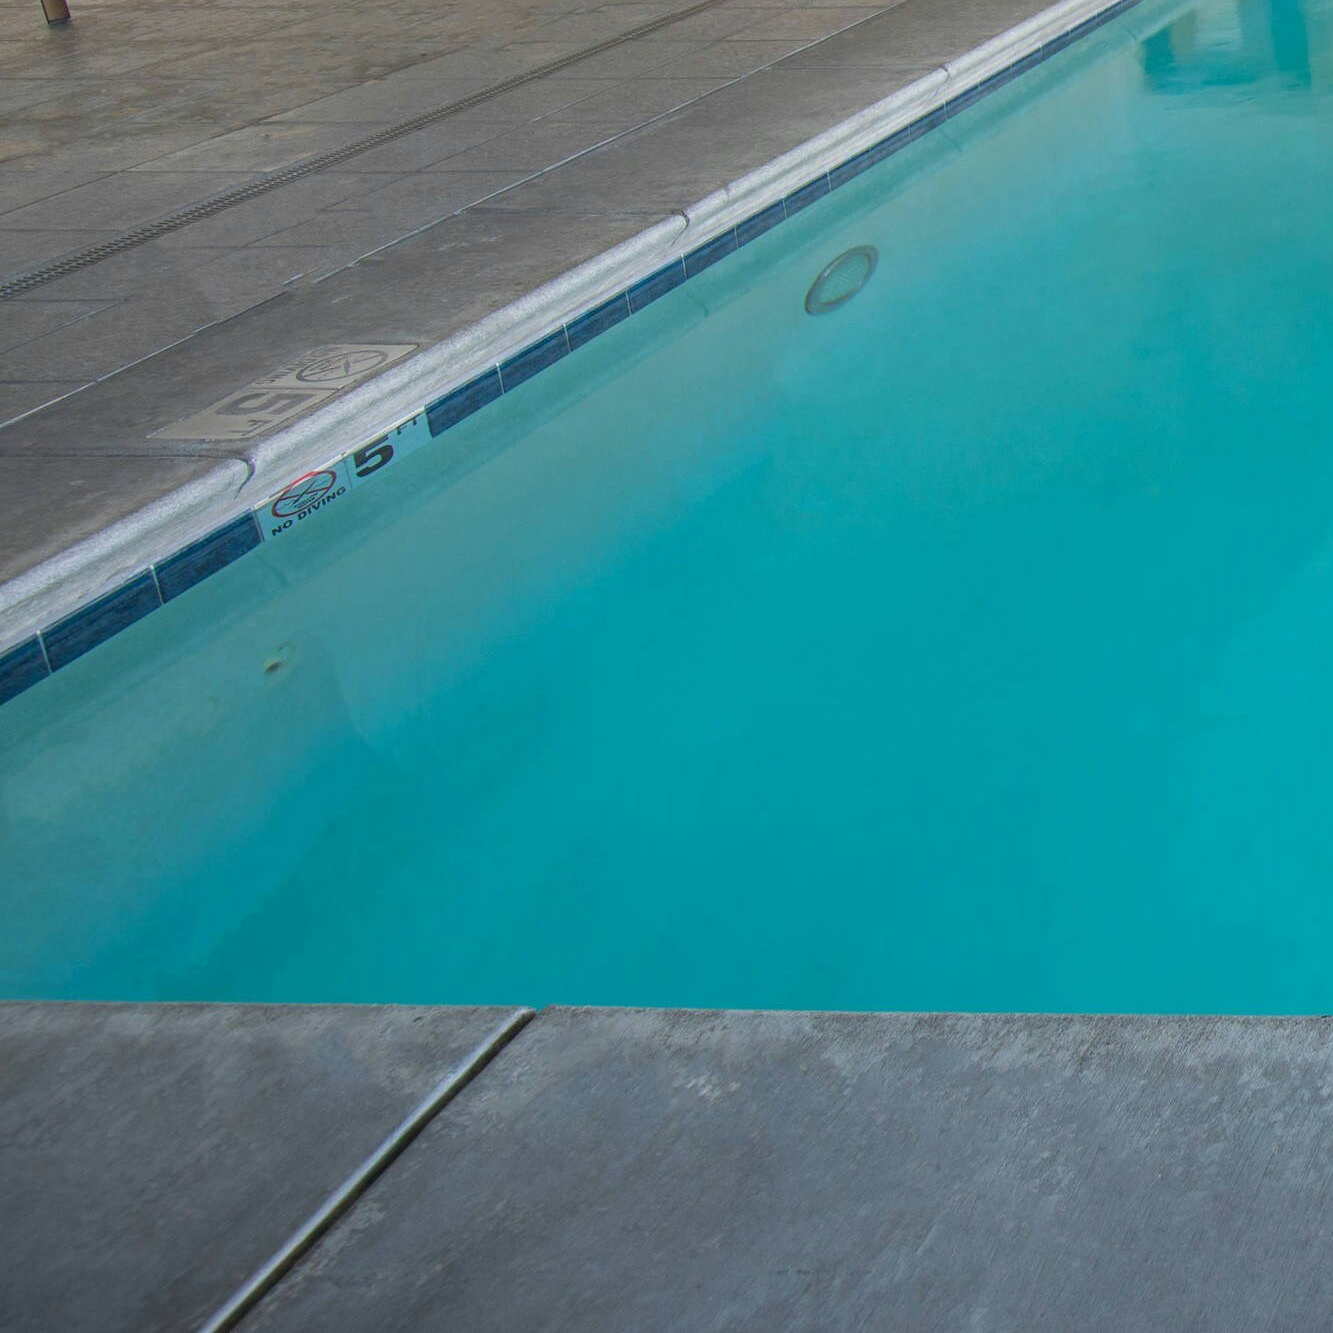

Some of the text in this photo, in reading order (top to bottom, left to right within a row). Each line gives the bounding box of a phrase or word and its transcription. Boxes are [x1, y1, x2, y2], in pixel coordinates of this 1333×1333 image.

[215, 392, 318, 416] 5
[353, 433, 394, 478] 5
[271, 519, 294, 536] NO
[297, 486, 347, 521] DIVING
